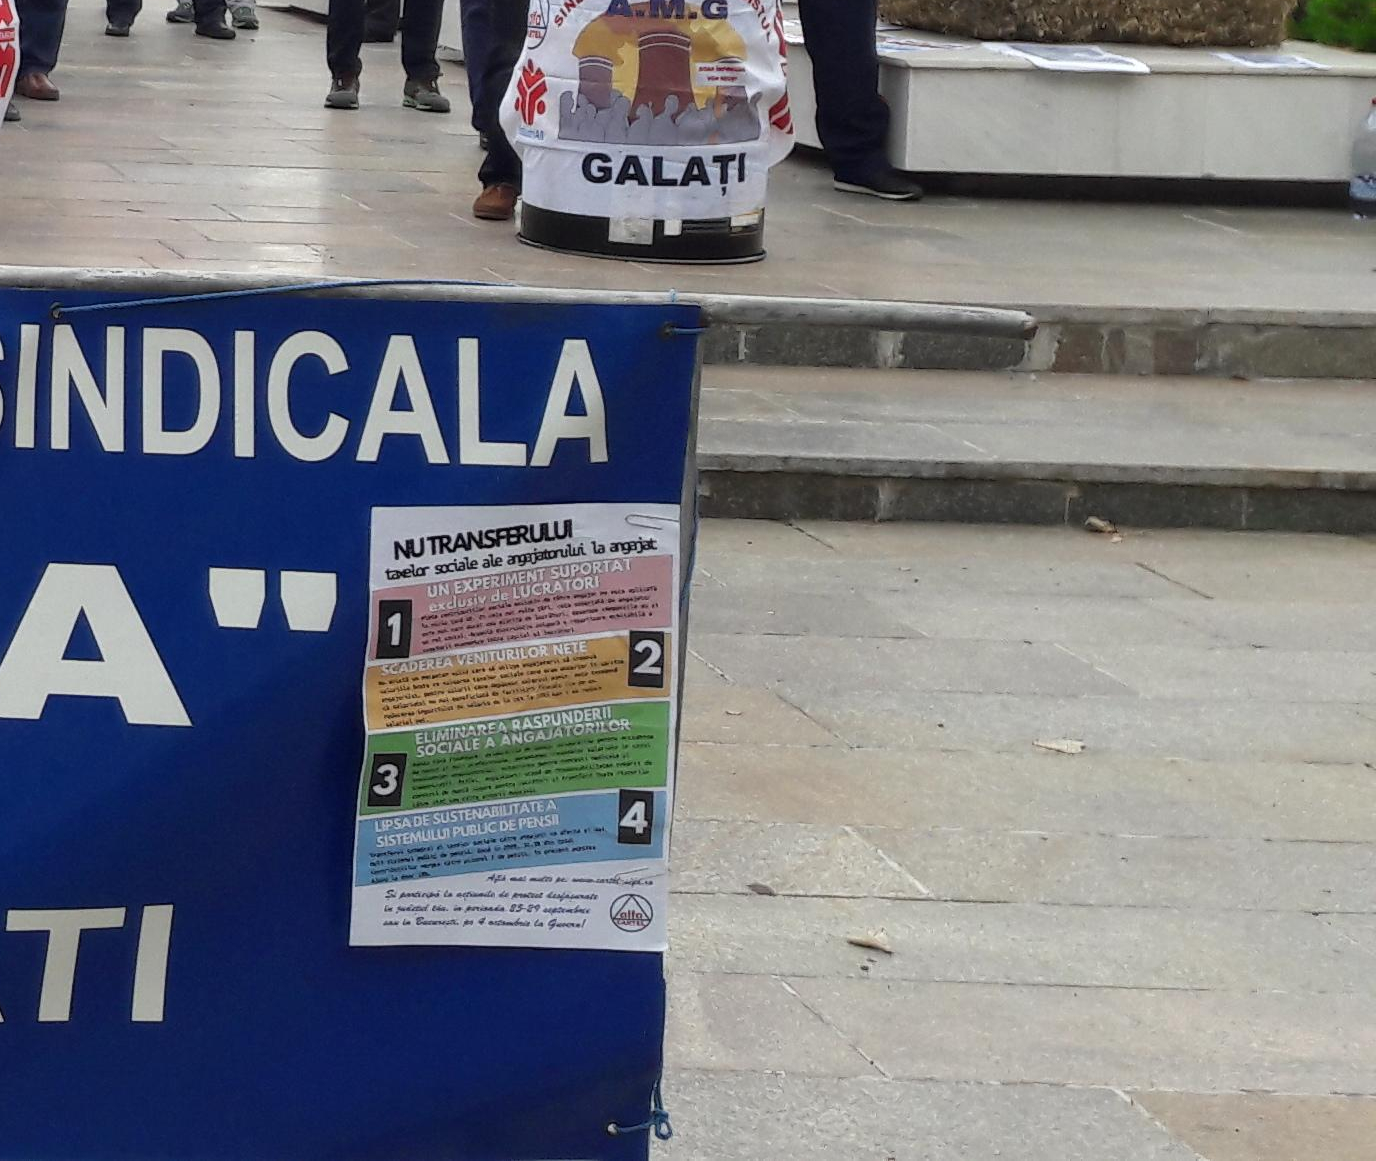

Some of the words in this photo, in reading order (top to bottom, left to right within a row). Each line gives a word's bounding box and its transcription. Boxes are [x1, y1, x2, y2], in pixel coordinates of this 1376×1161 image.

[582, 152, 747, 197] GALAȚI
[394, 539, 424, 560] NU
[426, 519, 574, 555] TRANSFERULUI
[385, 566, 430, 581] taxelor
[435, 556, 478, 574] sociale
[482, 553, 503, 568] ale
[507, 542, 587, 567] angajatorului
[592, 541, 606, 554] la
[427, 584, 449, 598] UN
[454, 570, 546, 594] EXPERIMENT
[550, 558, 632, 579] SUPORTAT
[429, 596, 486, 613] exclusiv
[490, 589, 509, 602] de
[512, 575, 600, 600] LUCRATORI
[387, 613, 402, 647] 1
[381, 657, 453, 676] SCADEREA
[457, 647, 548, 667] VENITURILOR
[553, 641, 587, 656] NETE
[633, 639, 663, 676] 2
[415, 724, 508, 745] ELIMINAREA
[512, 706, 612, 733] RASPUNDERII
[416, 739, 480, 758] SOCIALE
[485, 737, 497, 749] A
[501, 718, 631, 746] ANGAJATORILOR
[372, 764, 399, 796] 3
[374, 818, 411, 833] LIPSA
[413, 815, 430, 828] DE
[433, 801, 542, 825] SUSTENABILITATE
[545, 799, 557, 811] A
[376, 826, 451, 849] SISTEMULUI
[452, 822, 499, 837] PUBLIC
[501, 819, 518, 832] DE
[520, 814, 559, 831] PENSII
[620, 801, 648, 834] 4
